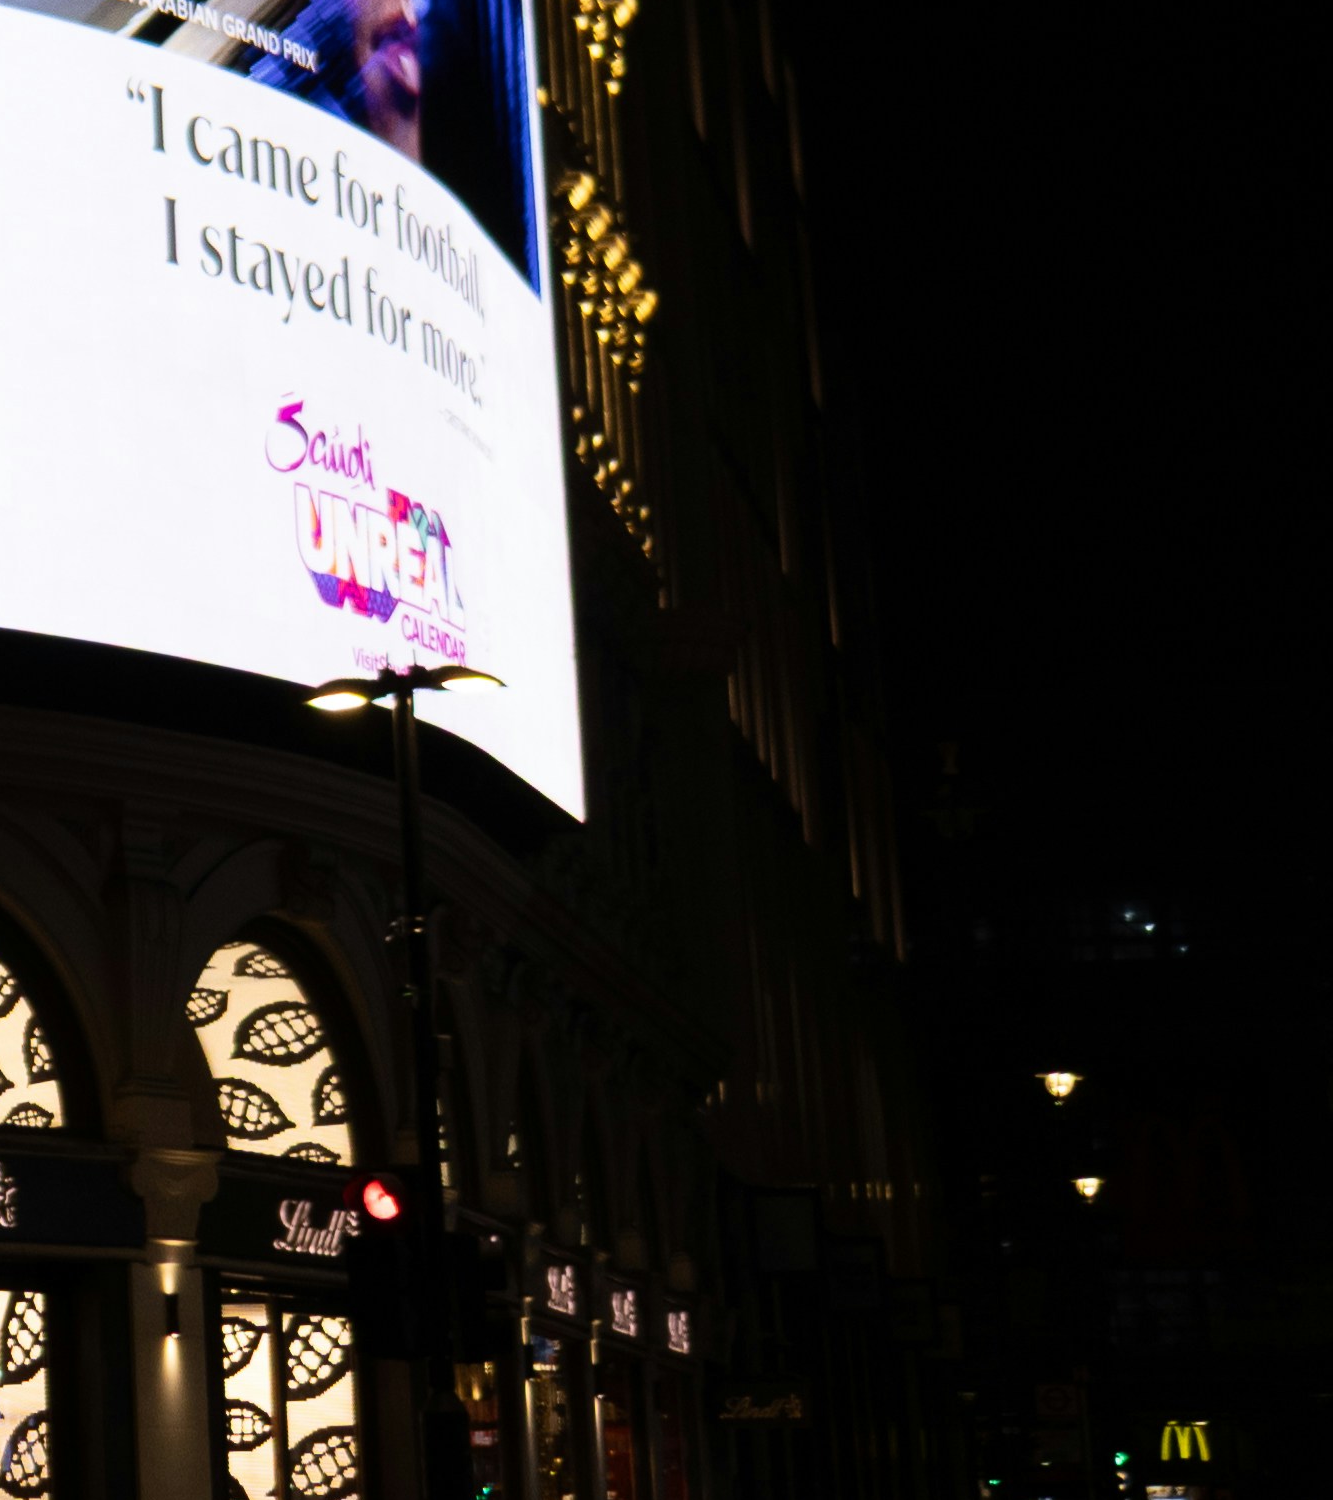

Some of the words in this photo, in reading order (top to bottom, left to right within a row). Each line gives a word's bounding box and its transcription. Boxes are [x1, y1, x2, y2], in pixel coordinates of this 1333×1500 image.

[221, 14, 281, 56] GRAND
[283, 38, 320, 73] PRIX
[186, 115, 320, 207] came
[331, 149, 384, 238] for
[393, 184, 485, 328] football,
[163, 196, 180, 266] I
[199, 225, 353, 325] stayed
[364, 266, 412, 353] for
[265, 392, 377, 490] Saudi
[293, 481, 468, 633] UNREAL
[400, 613, 468, 666] CALENDAR
[272, 1198, 345, 1257] Lindt
